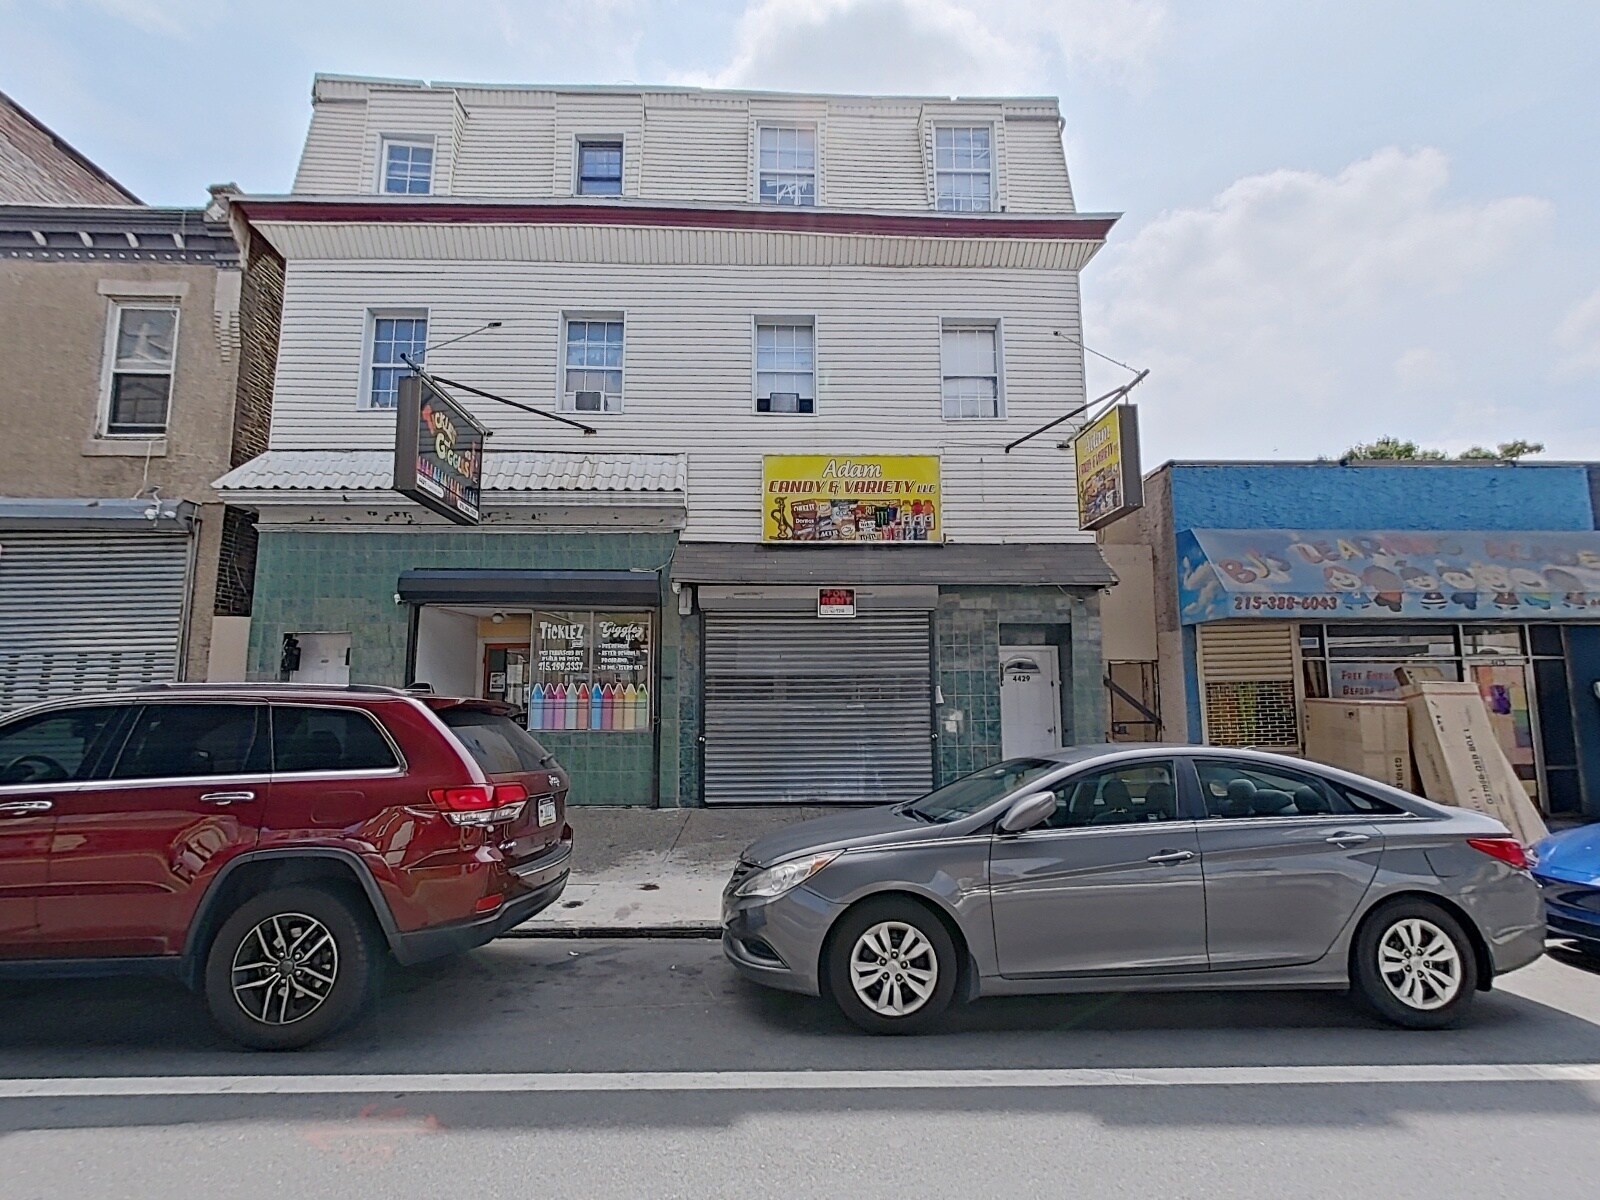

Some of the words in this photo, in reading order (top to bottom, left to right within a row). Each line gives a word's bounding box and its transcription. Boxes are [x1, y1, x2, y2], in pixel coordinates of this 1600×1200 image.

[822, 459, 883, 478] Adam
[768, 480, 826, 494] CANDY
[828, 480, 841, 495] &
[844, 480, 917, 494] VARIETY
[821, 596, 852, 605] RENT
[1234, 596, 1338, 610] 215-388-6043
